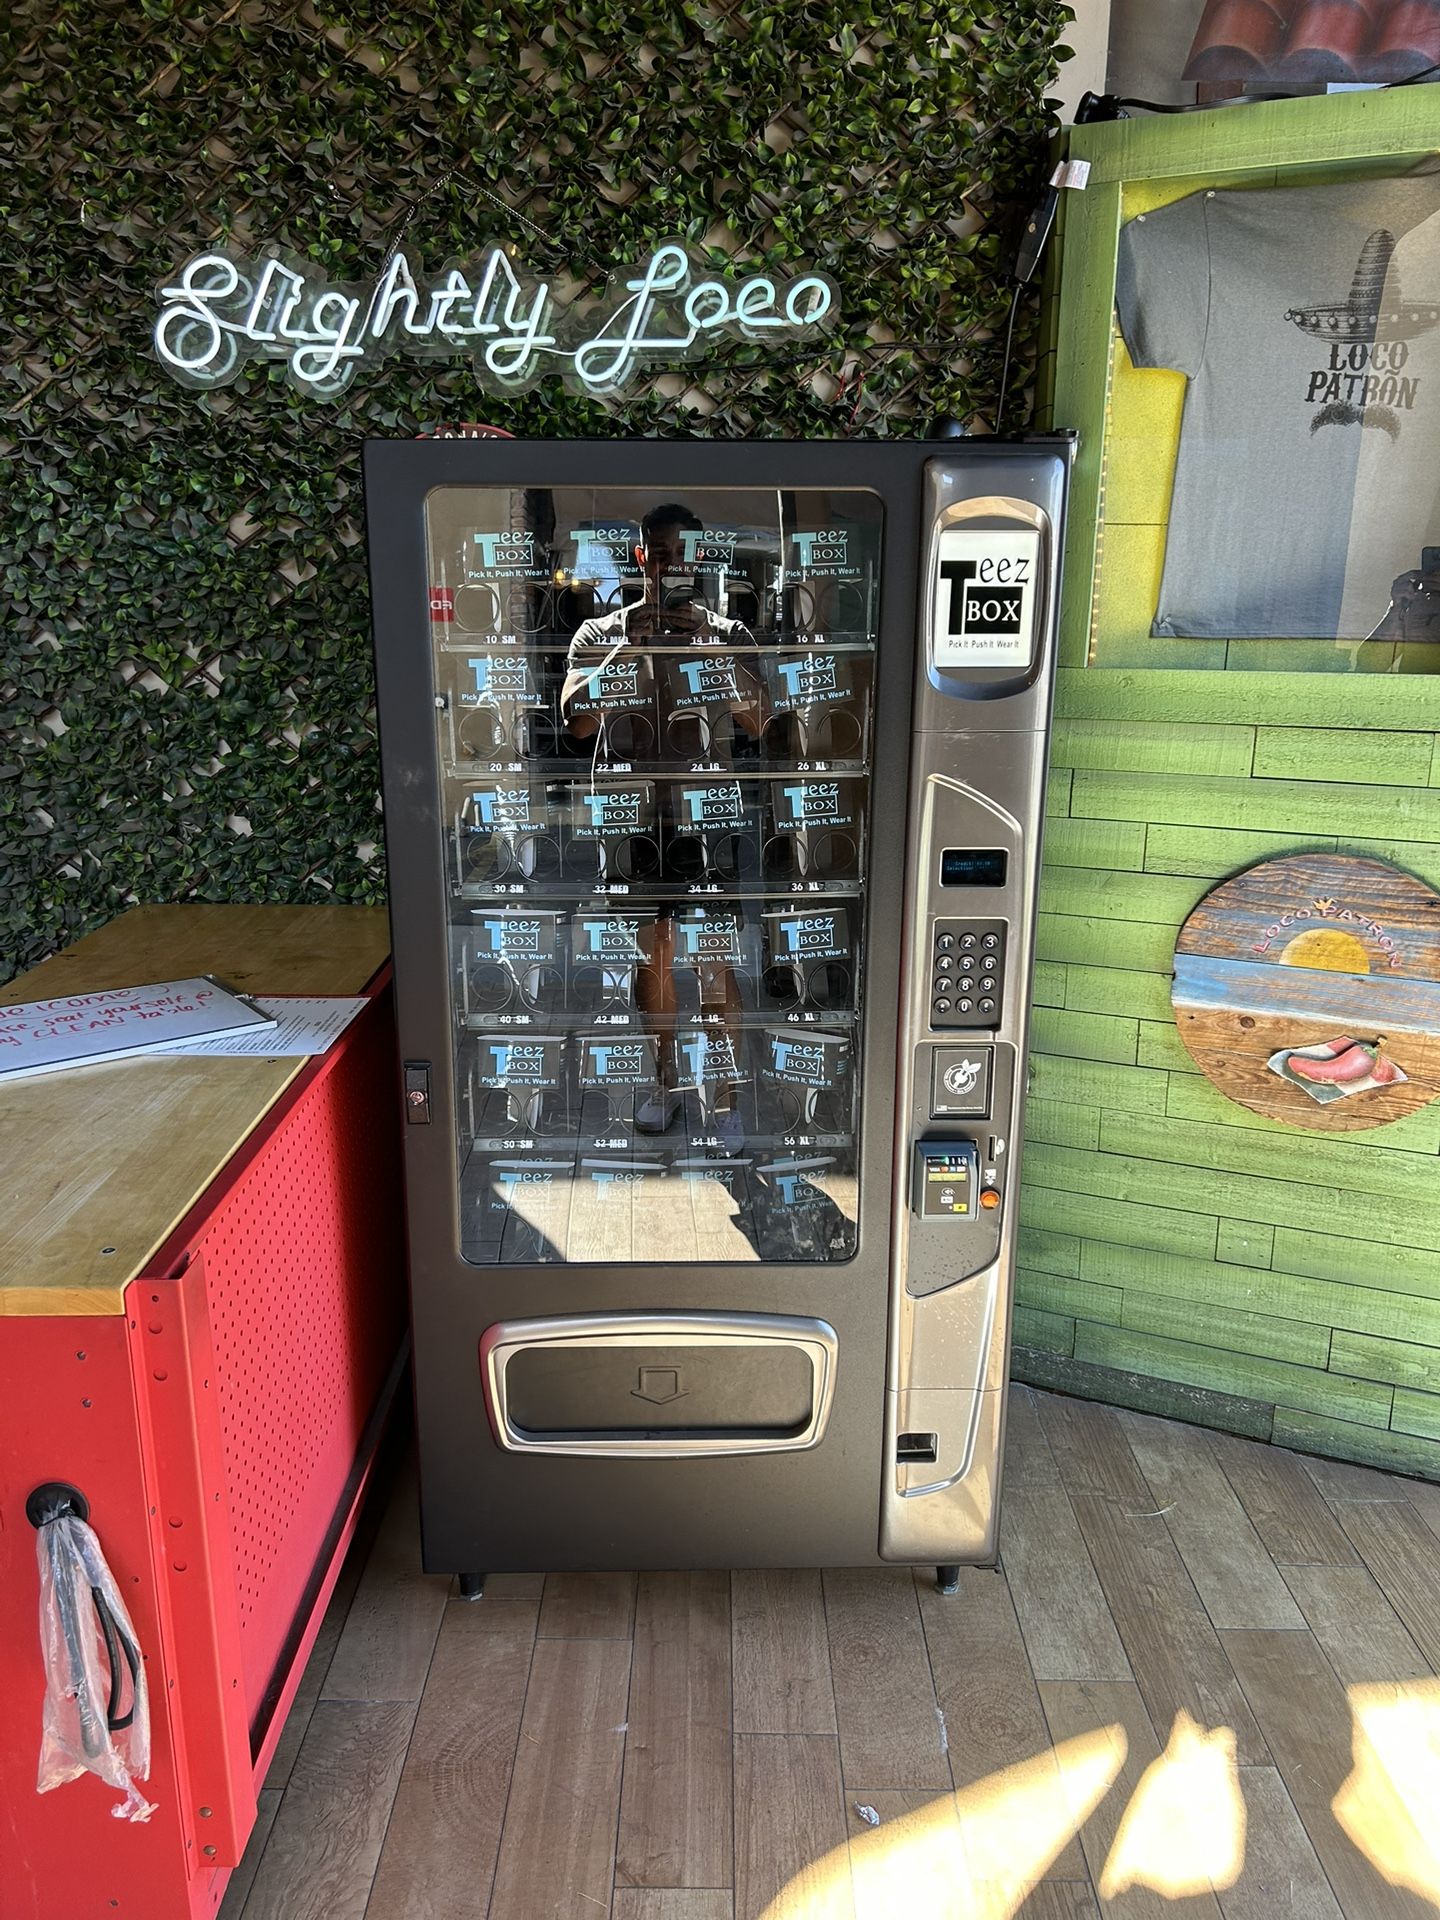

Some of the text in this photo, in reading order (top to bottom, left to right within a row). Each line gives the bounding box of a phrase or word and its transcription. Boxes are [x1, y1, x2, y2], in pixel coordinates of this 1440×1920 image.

[156, 244, 829, 383] Slightly Loco
[1327, 341, 1410, 371] LOCO
[474, 531, 534, 567] Teez
[570, 528, 630, 563] Teez
[679, 530, 737, 563] Teez
[792, 530, 848, 566] Teez
[496, 549, 532, 561] BOX
[591, 546, 626, 557] BOX
[696, 548, 731, 560] BOX
[812, 548, 844, 559] BOX
[524, 569, 542, 577] Wear
[940, 558, 1030, 635] Teez
[967, 600, 1020, 621] BOX
[485, 635, 516, 644] 10 SM
[596, 636, 608, 644] 12
[691, 636, 703, 644] 14
[796, 635, 824, 643] 16 XL
[949, 640, 962, 648] Pick
[971, 640, 988, 648] Push
[997, 640, 1013, 648] Wear
[679, 656, 736, 694] Teez
[701, 673, 733, 686] BOX
[778, 655, 836, 696] Teez
[799, 673, 834, 687] BOX
[601, 680, 634, 692] BOX
[600, 700, 618, 708] Push
[490, 763, 522, 771] 20 SM
[597, 763, 632, 772] 22 MED
[691, 763, 703, 771] 24
[797, 762, 827, 770] 26 XL
[683, 786, 739, 821] Teez
[784, 783, 839, 818] Teez
[804, 799, 836, 811] BOX
[493, 806, 527, 816] BOX
[584, 793, 640, 826] Teez
[604, 809, 636, 820] BOX
[703, 803, 736, 815] BOX
[494, 885, 524, 893] 30 SM
[595, 885, 629, 893] 32 MED
[791, 882, 819, 891] 36 XL
[485, 921, 540, 950] Teez
[584, 921, 639, 951] Teez
[781, 917, 834, 951] Teez
[1252, 908, 1311, 953] LOCO
[504, 936, 536, 946] BOX
[602, 936, 634, 946] BOX
[680, 921, 735, 953] Teez
[699, 937, 730, 947] BOX
[800, 933, 831, 945] BOX
[943, 937, 993, 947] 1 2 3
[1320, 906, 1402, 968] PATRON
[941, 959, 992, 968] 4 5 6
[941, 980, 991, 990] 7 8 9
[0, 990, 132, 1018] elcome
[961, 1002, 968, 1011] 0
[44, 1012, 85, 1026] seat
[97, 995, 186, 1018] yourself
[500, 1016, 529, 1024] 40 SM
[611, 1016, 629, 1024] MED
[788, 1013, 814, 1022] 46 XL
[33, 1016, 125, 1037] CLEAN
[590, 1045, 643, 1075] Teez
[703, 1055, 732, 1066] BOX
[772, 1041, 823, 1071] Teez
[508, 1061, 540, 1070] BOX
[608, 1060, 639, 1069] BOX
[786, 1059, 817, 1071] BOX
[504, 1140, 533, 1148] 50 SM
[595, 1139, 627, 1148] 52 MED
[784, 1136, 810, 1145] 56 XL
